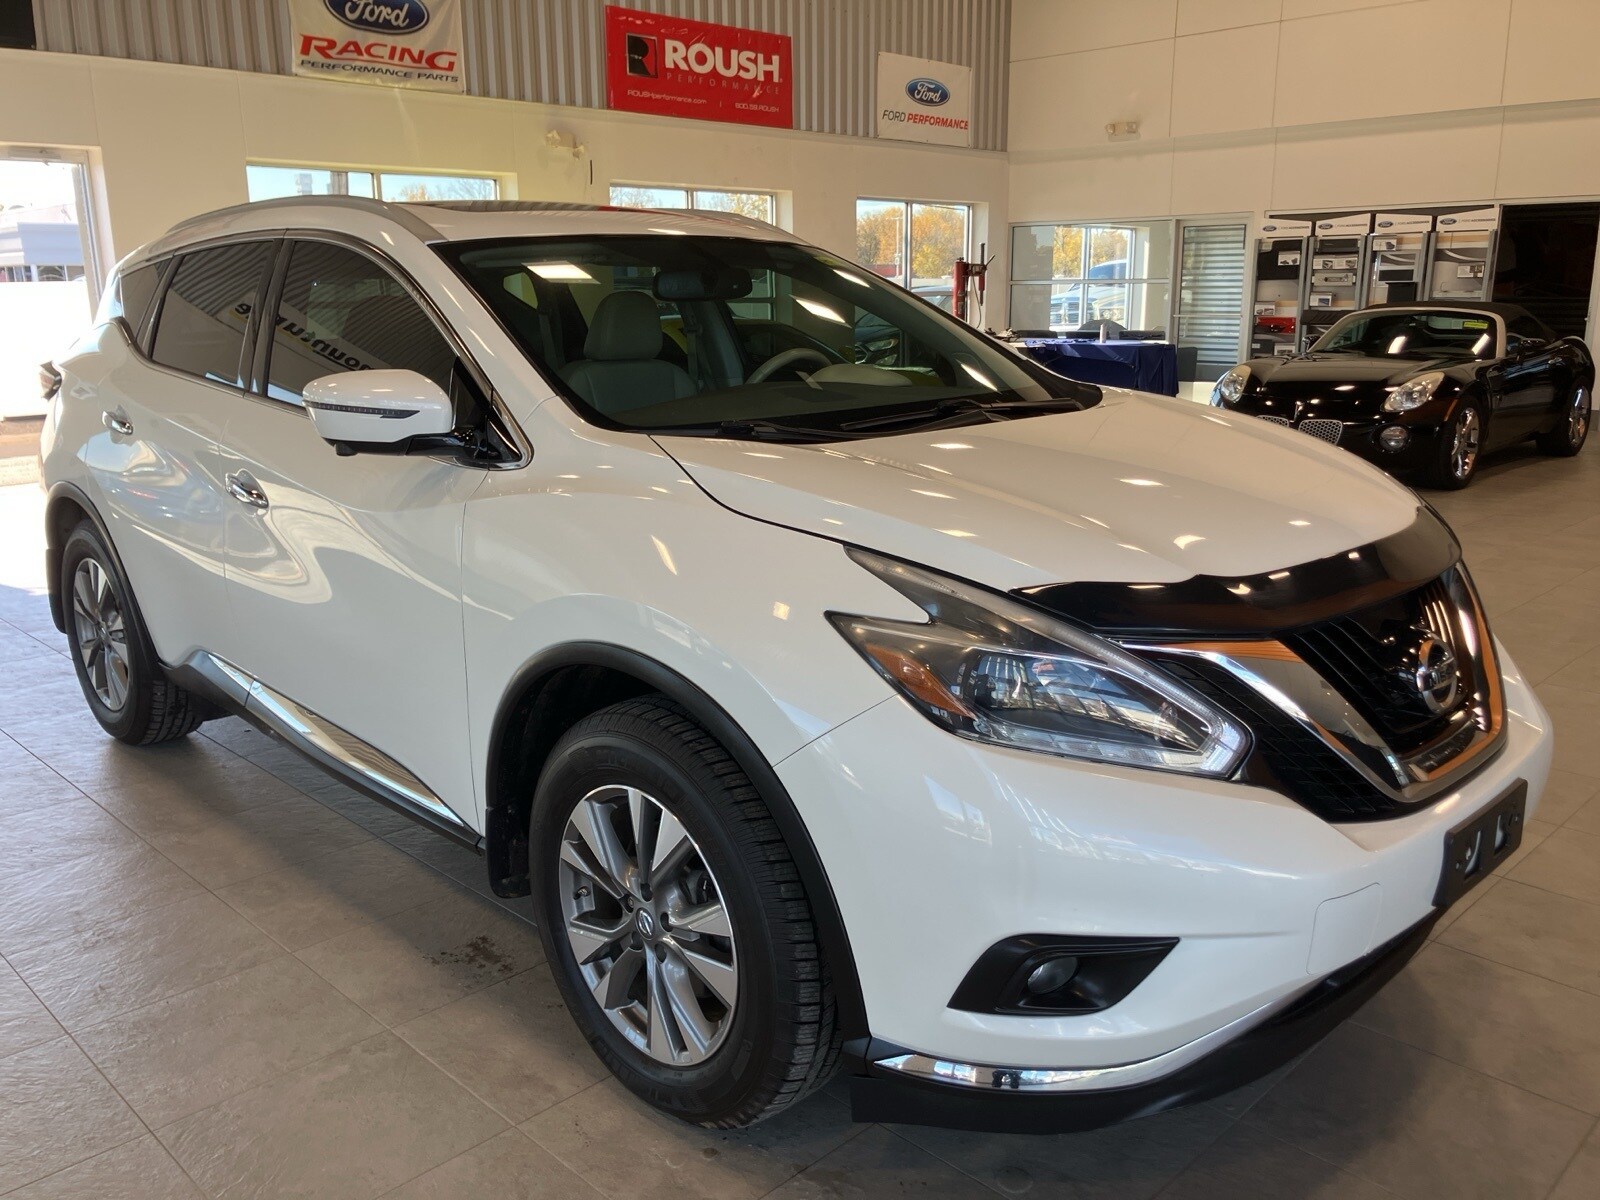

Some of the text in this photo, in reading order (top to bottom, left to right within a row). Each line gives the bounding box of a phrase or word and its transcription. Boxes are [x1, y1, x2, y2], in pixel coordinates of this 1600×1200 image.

[299, 33, 457, 72] RACING
[664, 39, 780, 83] ROUSH
[300, 59, 459, 83] PERFORMANCE PARTS
[666, 72, 780, 95] PERFORMANCE
[914, 81, 942, 103] Ford
[882, 109, 969, 130] FORD PERFORMANCE
